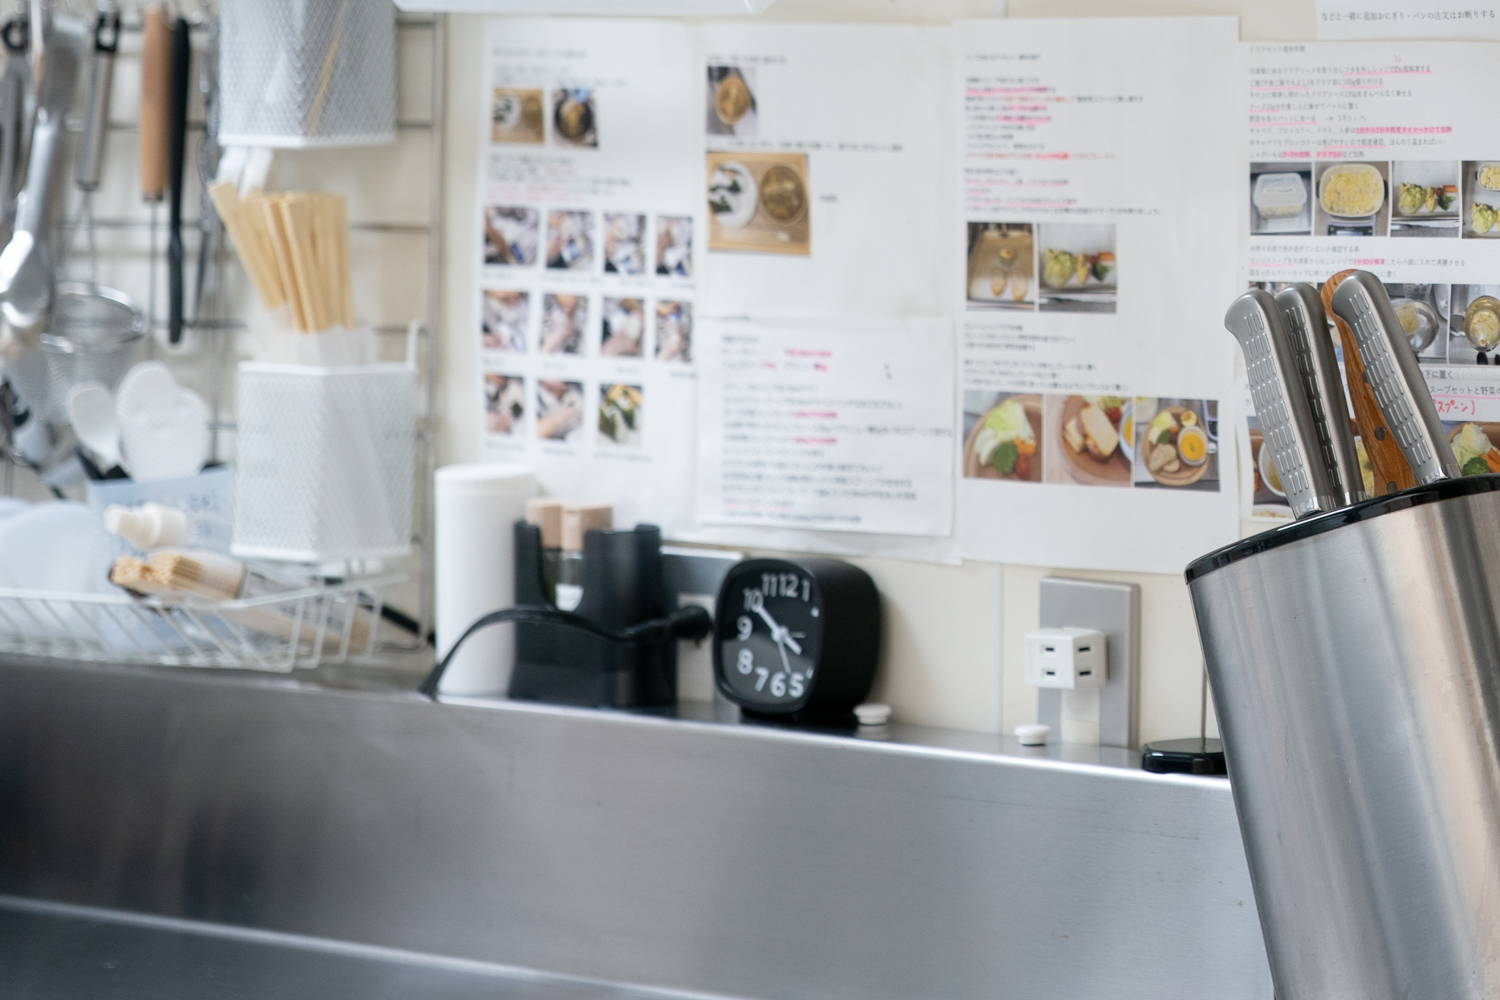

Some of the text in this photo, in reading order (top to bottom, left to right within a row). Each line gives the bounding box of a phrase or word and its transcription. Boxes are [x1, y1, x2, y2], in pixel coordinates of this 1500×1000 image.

[737, 615, 753, 641] 9
[737, 648, 754, 675] 8
[754, 667, 770, 692] 7
[770, 672, 786, 697] 6
[788, 673, 805, 697] 5
